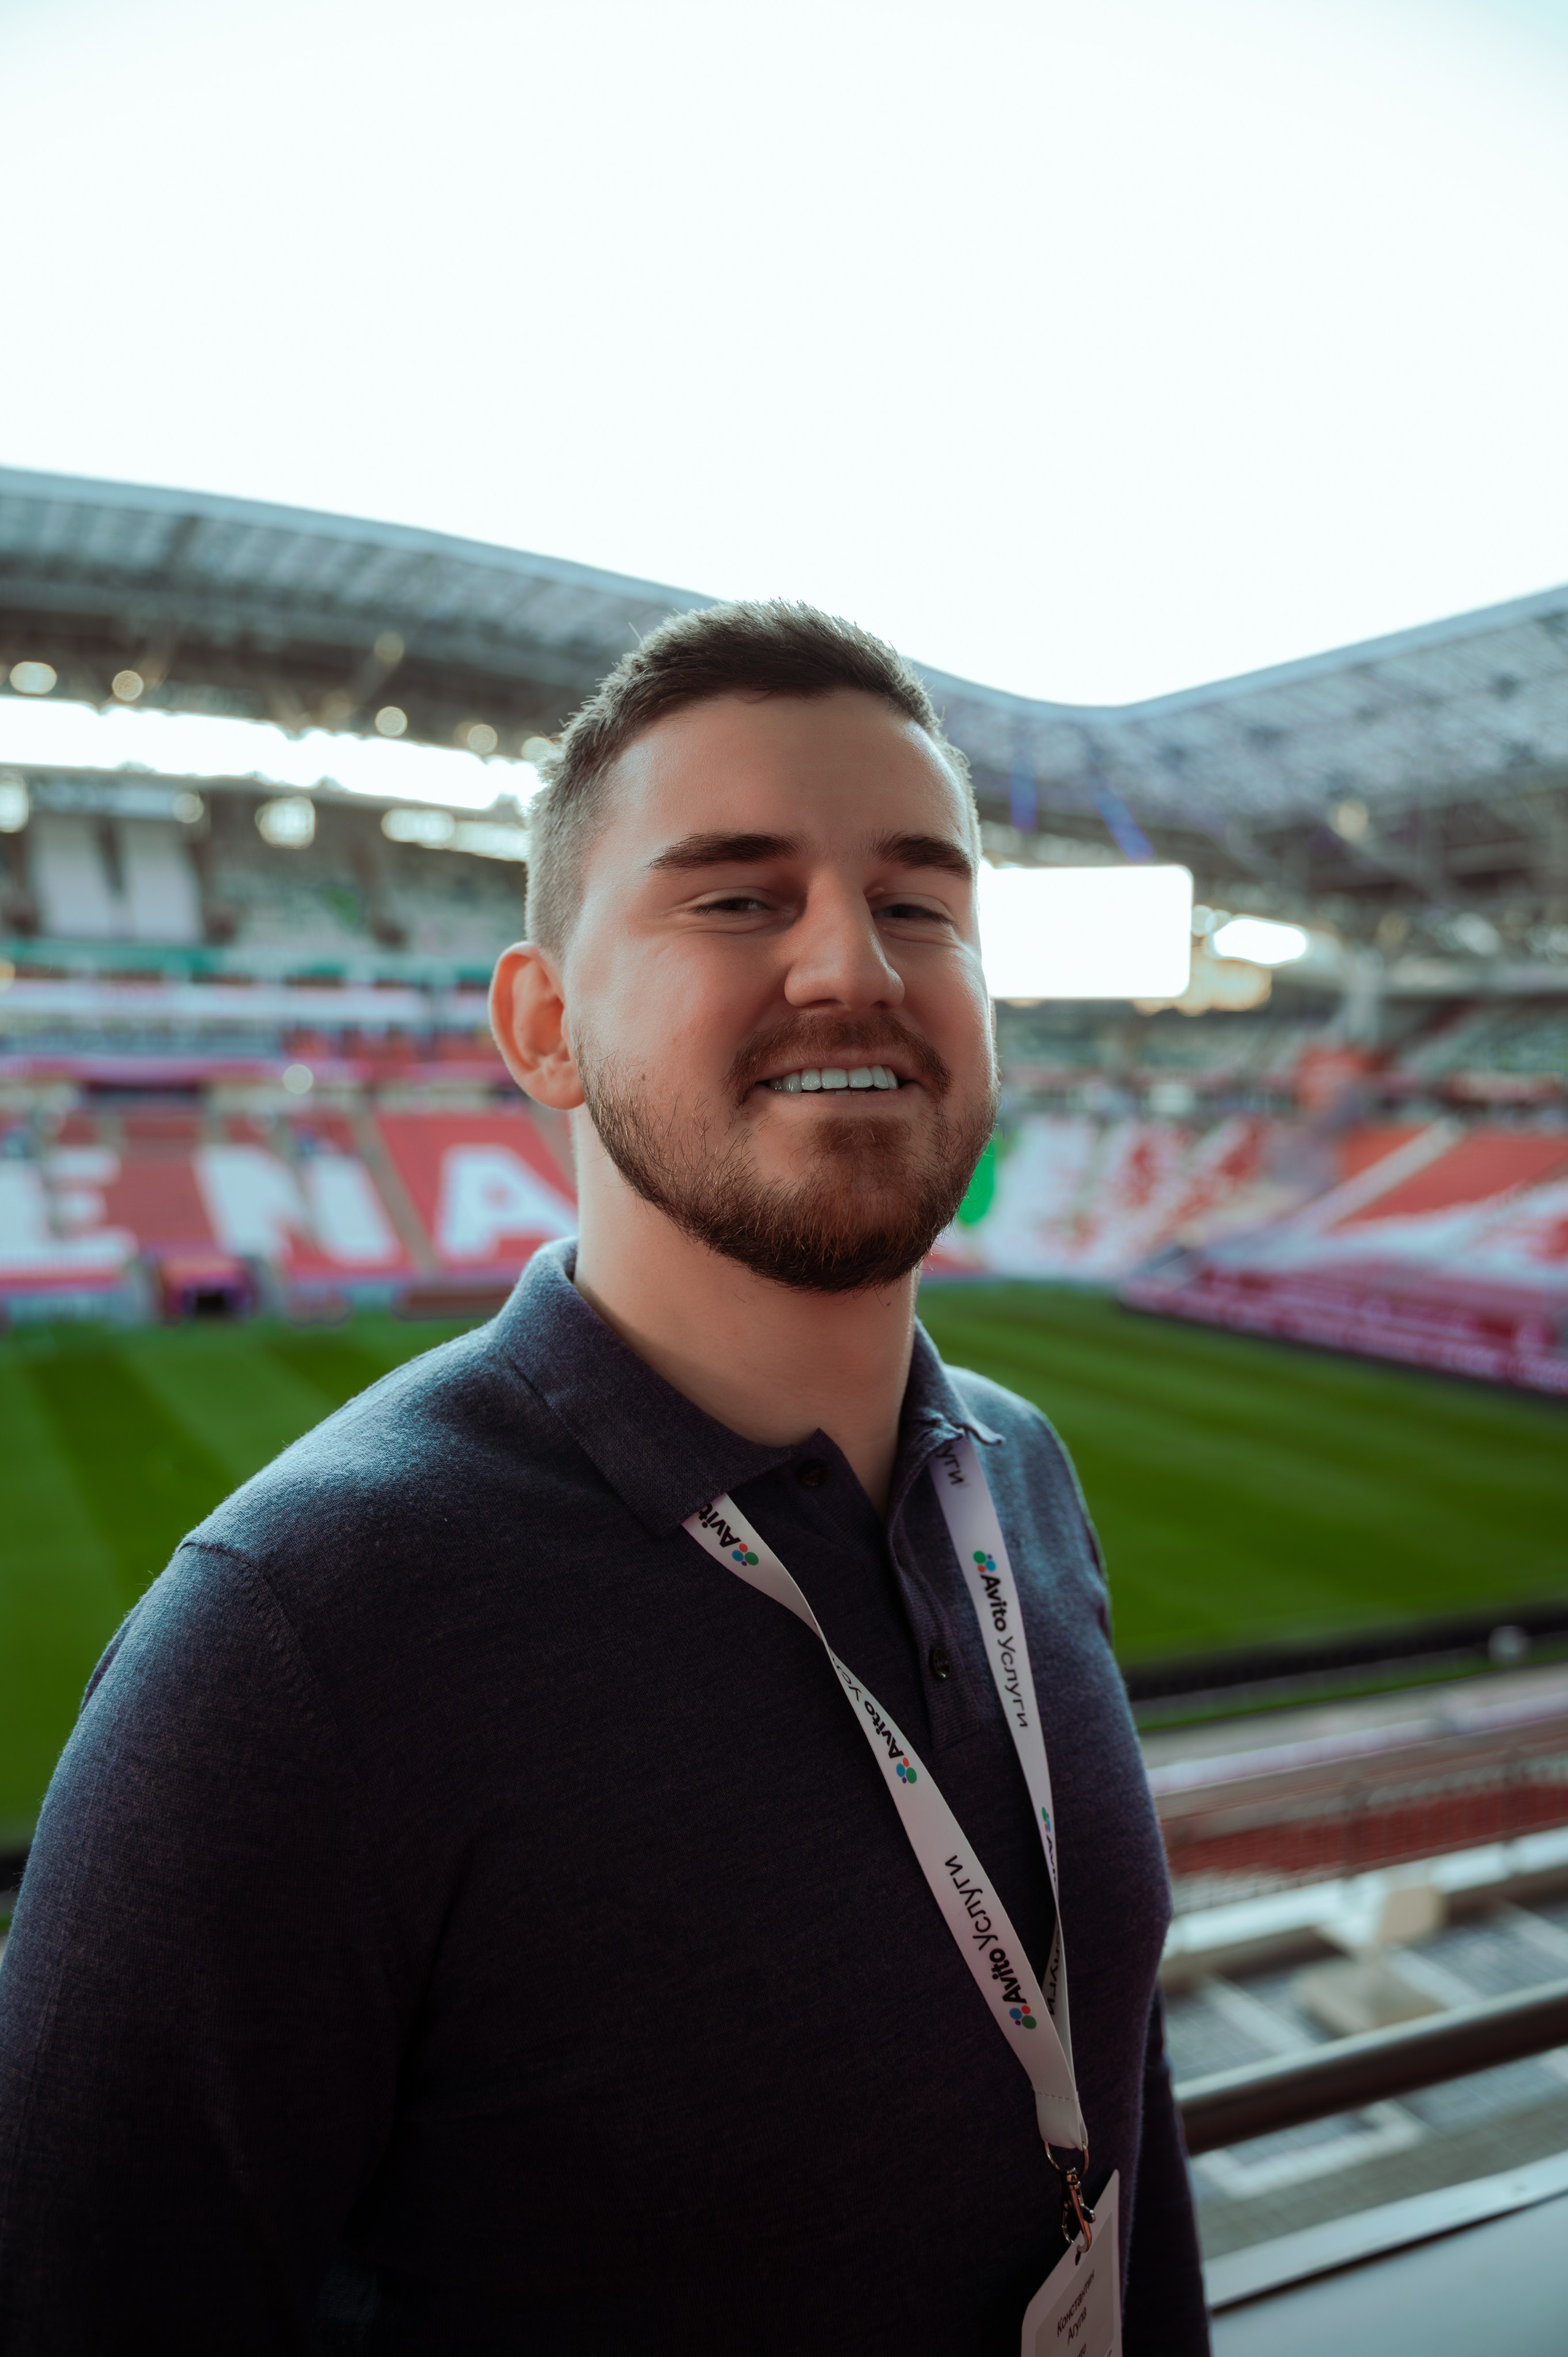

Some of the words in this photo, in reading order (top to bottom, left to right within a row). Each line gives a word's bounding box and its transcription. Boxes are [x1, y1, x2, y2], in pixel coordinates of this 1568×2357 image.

[935, 1446, 964, 1485] уги
[698, 1503, 741, 1548] Avit
[981, 1574, 1007, 1632] Avito
[997, 1636, 1028, 1727] Услуги
[864, 1700, 905, 1759] Avito
[945, 1855, 998, 1952] Услуги
[989, 1948, 1027, 2004] Avito
